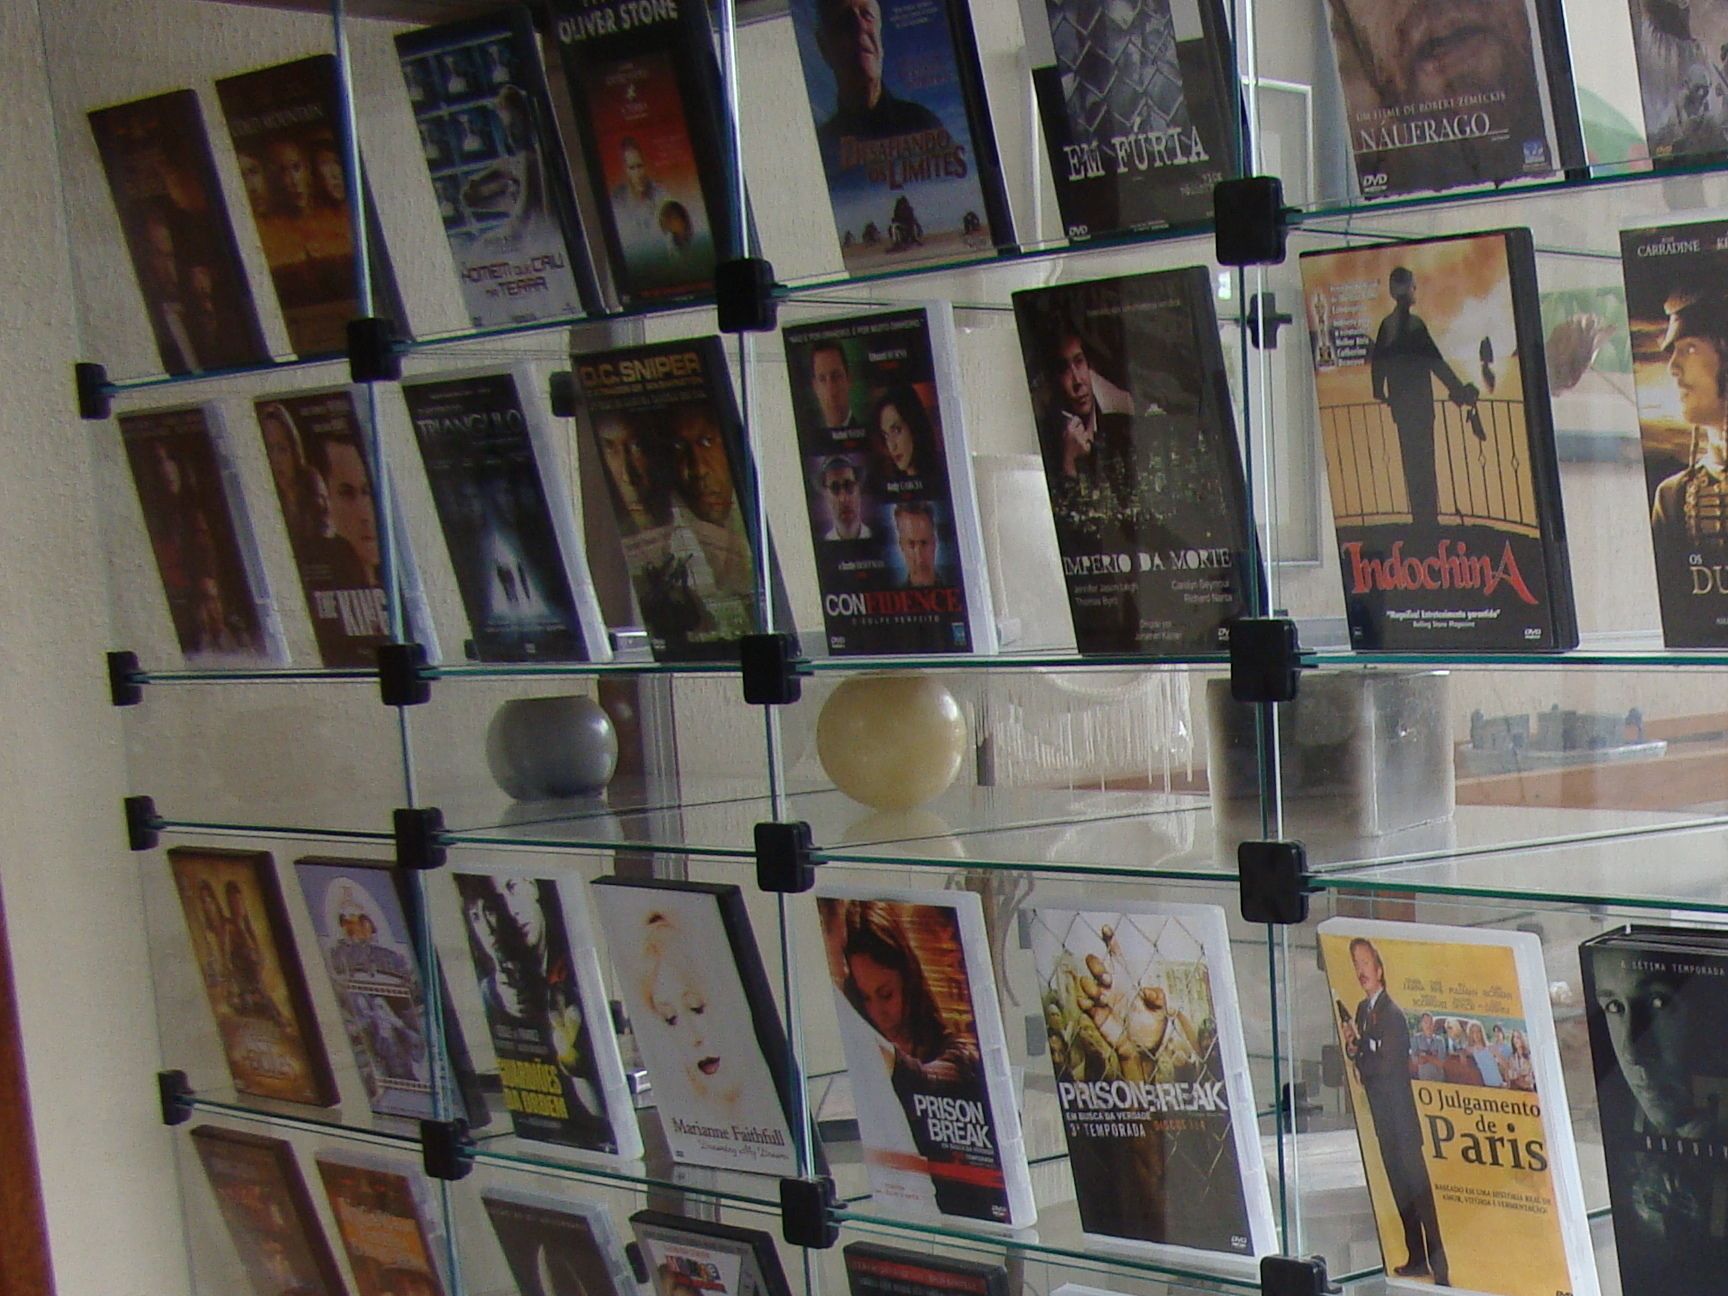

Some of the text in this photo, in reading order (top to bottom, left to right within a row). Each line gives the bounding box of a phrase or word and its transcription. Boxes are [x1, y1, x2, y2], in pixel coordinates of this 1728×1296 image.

[558, 0, 679, 45] OLIVER STONE
[1419, 90, 1507, 113] ROBERT ZEMECKIS
[1359, 112, 1491, 151] NÁUFRAGO
[840, 128, 951, 170] DESAFIANDO
[1064, 115, 1210, 181] EM FÚRIA
[886, 144, 969, 190] LIMITES
[1362, 174, 1388, 186] DVD
[1069, 225, 1089, 237] DVD
[1637, 239, 1700, 258] CARRADINE
[498, 276, 548, 299] TERRA
[619, 350, 701, 381] SNIPER
[1138, 552, 1165, 572] DA
[1168, 547, 1233, 571] MORTE
[1689, 554, 1703, 565] OS
[313, 589, 338, 619] THE
[825, 588, 962, 616] CONFIDENCE
[1632, 959, 1667, 972] SÉTIMA
[1672, 963, 1726, 976] TEMPORADA
[913, 1093, 985, 1125] PRISON
[1079, 1111, 1151, 1121] BUSCA DA VERDADE
[1417, 1087, 1542, 1118] O Julgamento
[673, 1117, 785, 1147] Marianne Faithfull
[927, 1117, 993, 1149] BREAK
[1085, 1122, 1147, 1138] TEMPORADA
[1474, 1113, 1498, 1134] de
[1423, 1113, 1549, 1173] Paris
[1231, 1235, 1248, 1244] DVD
